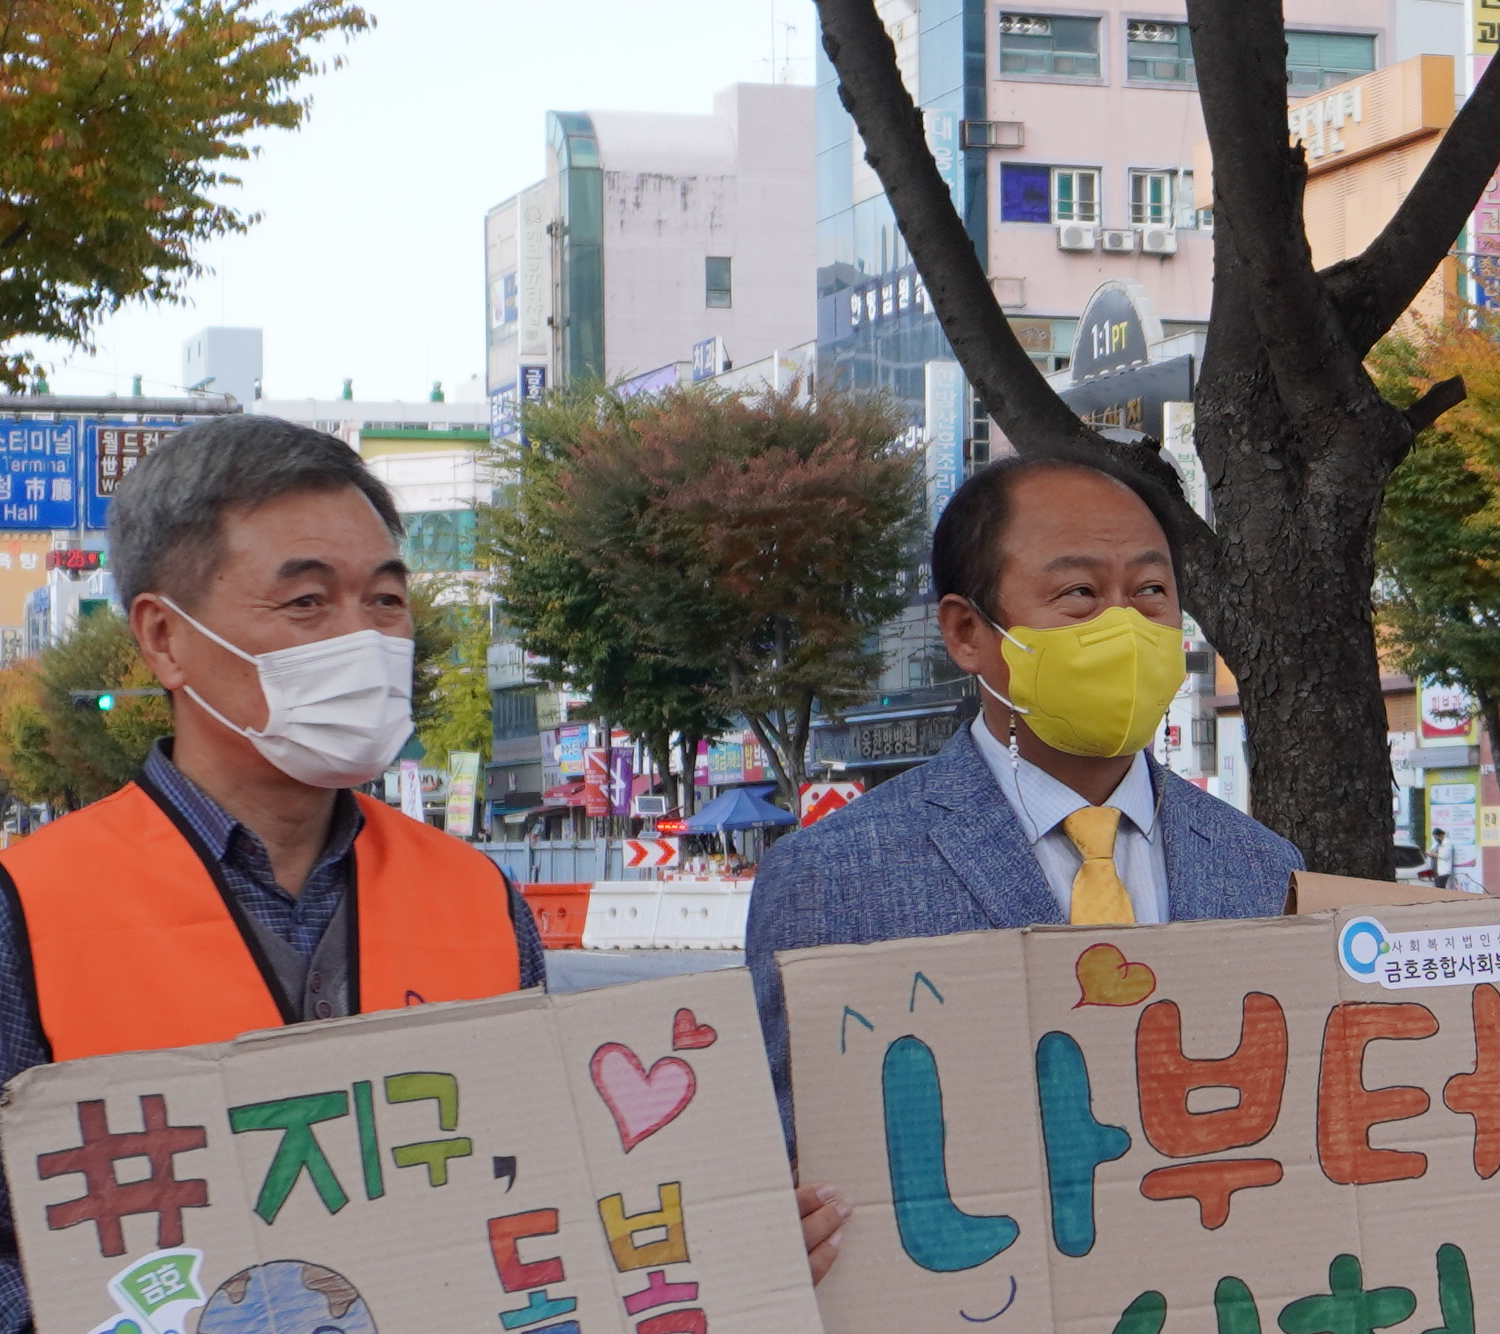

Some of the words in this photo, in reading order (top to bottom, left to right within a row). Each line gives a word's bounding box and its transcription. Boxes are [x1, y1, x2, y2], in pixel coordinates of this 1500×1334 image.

[1112, 320, 1129, 354] PT
[3, 502, 38, 521] Hall
[136, 1268, 187, 1305] 금호
